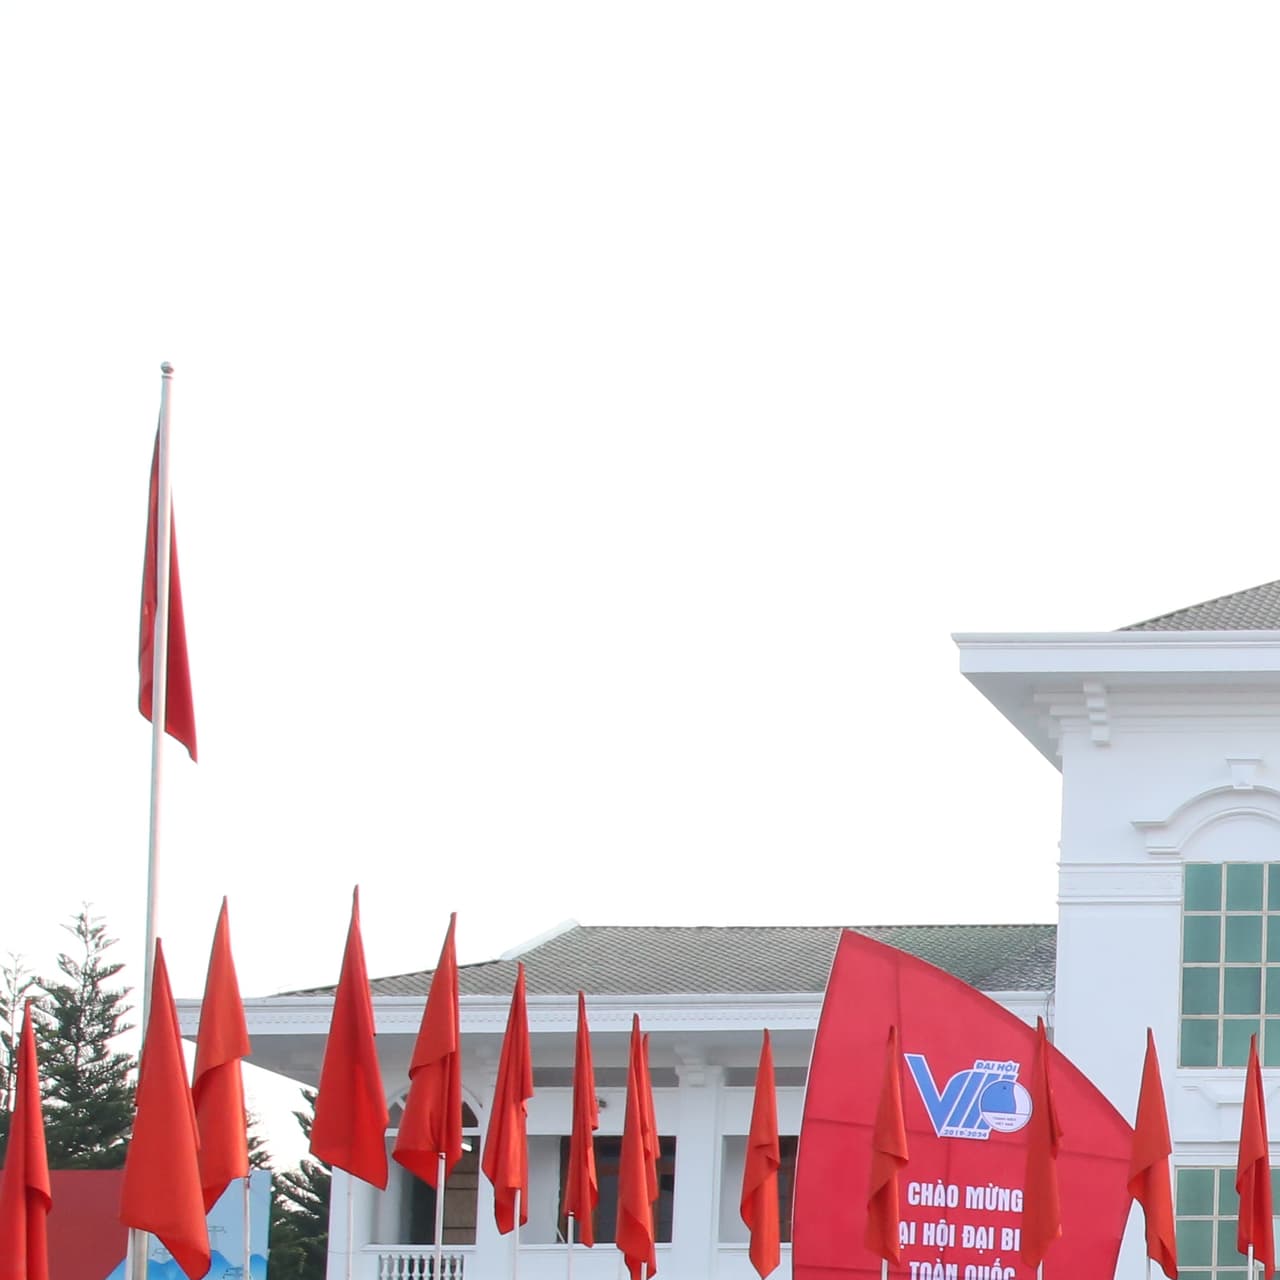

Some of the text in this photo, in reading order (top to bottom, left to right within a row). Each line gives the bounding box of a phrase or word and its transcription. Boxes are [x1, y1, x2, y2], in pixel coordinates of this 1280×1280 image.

[907, 1179, 1024, 1213] CHÀO MỪNG
[898, 1219, 1020, 1254] ẠI HỘI ĐẠI BI
